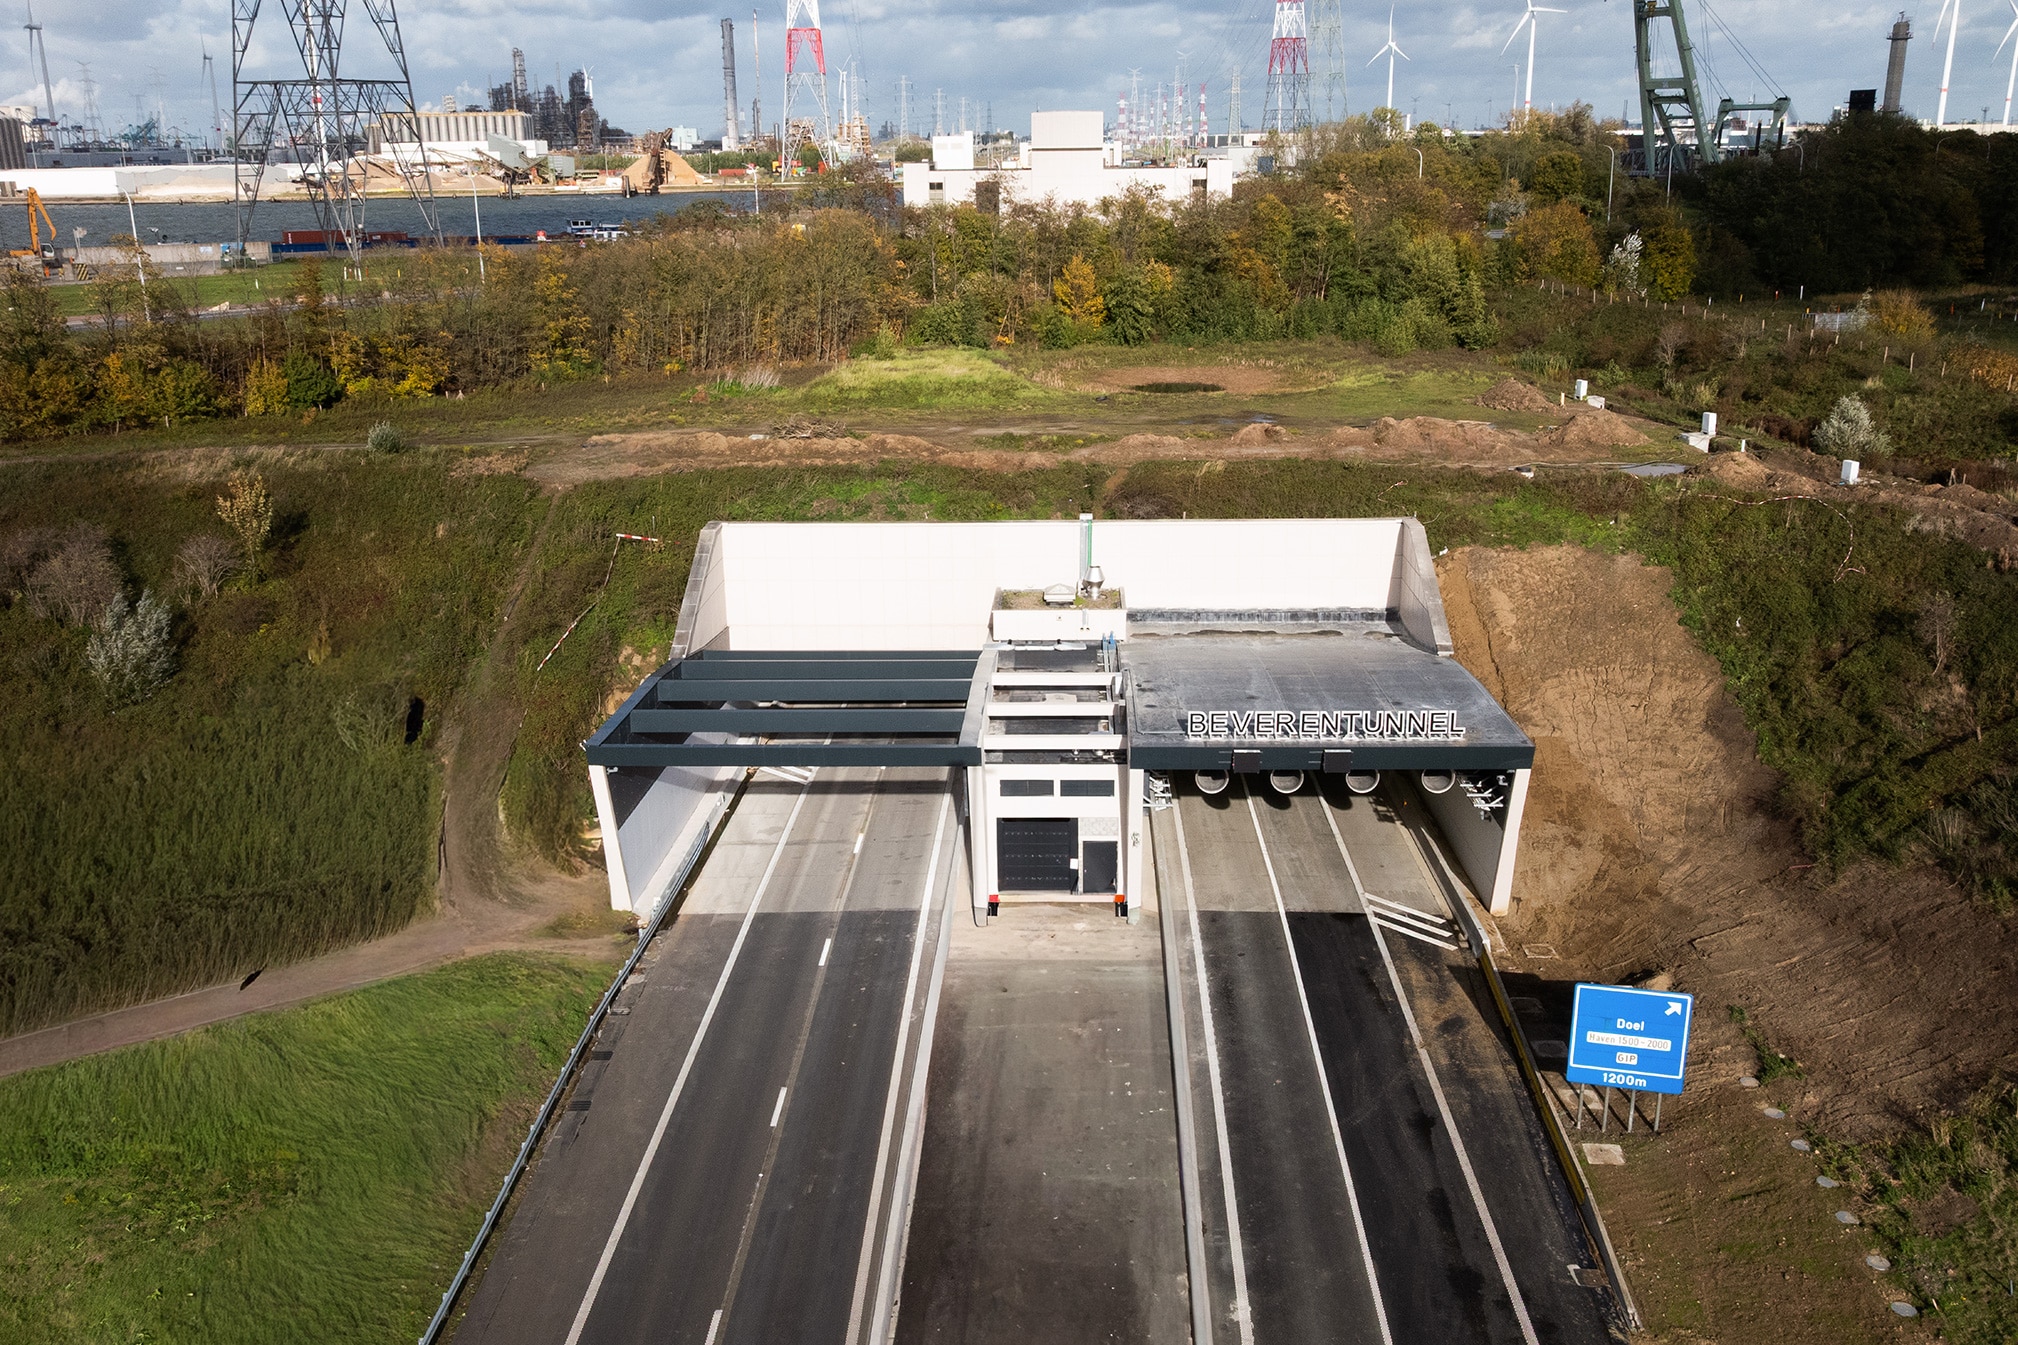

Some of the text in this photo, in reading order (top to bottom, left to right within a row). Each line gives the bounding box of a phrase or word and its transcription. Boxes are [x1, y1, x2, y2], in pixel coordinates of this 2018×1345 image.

[1187, 709, 1466, 736] BEVERENTUNNEL
[1616, 1018, 1645, 1031] Doel
[1589, 1033, 1615, 1044] Haven
[1617, 1054, 1637, 1063] GIP
[1602, 1072, 1647, 1087] 1200m
